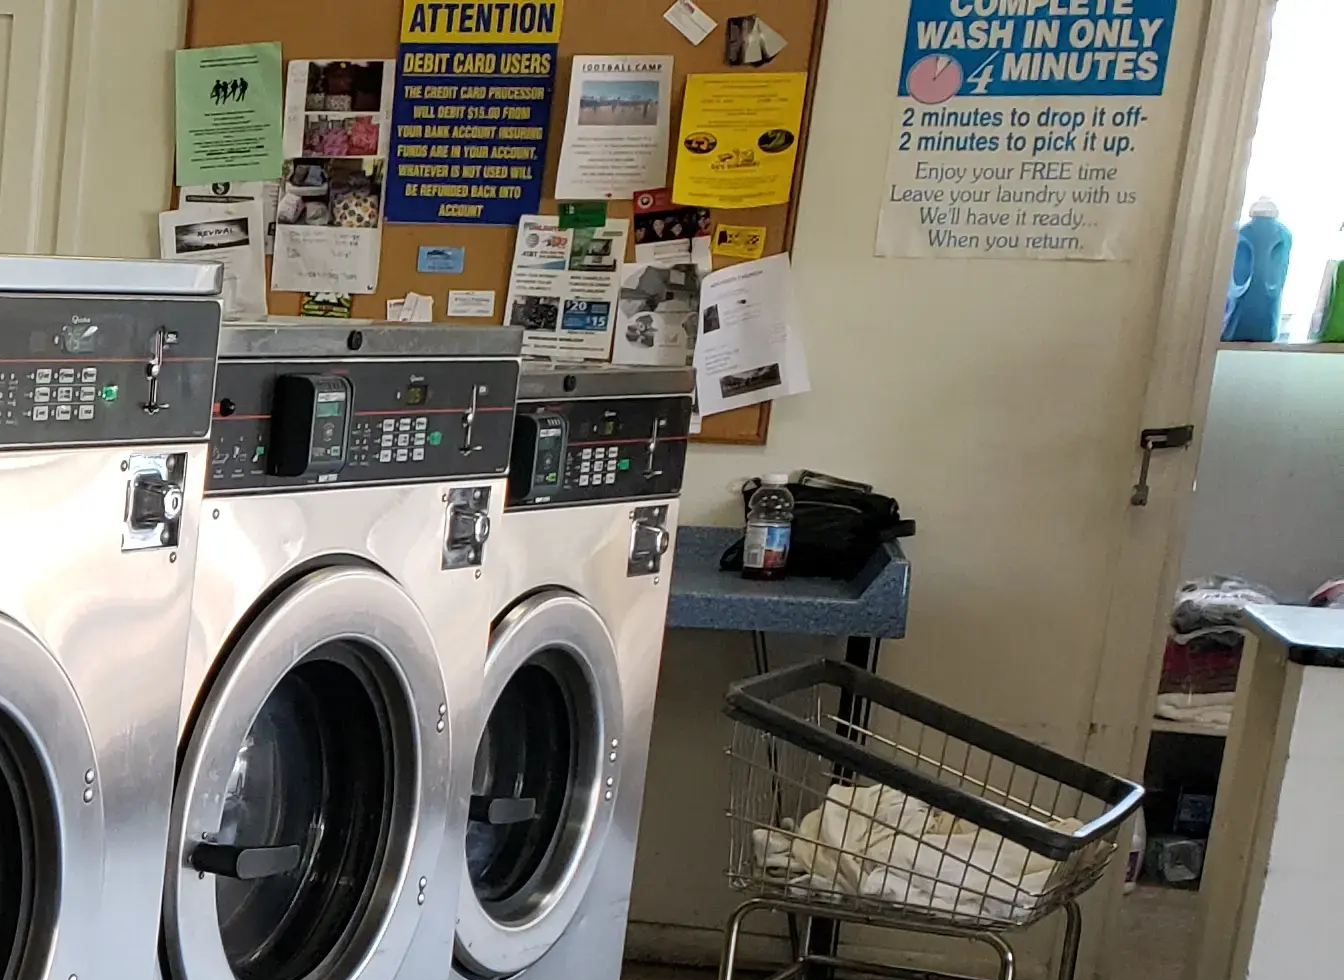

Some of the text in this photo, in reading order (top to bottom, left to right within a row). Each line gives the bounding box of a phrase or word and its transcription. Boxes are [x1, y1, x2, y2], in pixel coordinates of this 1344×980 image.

[409, 3, 556, 33] ATTENTION
[917, 18, 1164, 50] WASH IN ONLY
[403, 53, 552, 75] DEBIT CARD USERS
[582, 63, 663, 71] FOOTBALL CAMP
[966, 50, 1160, 94] 4 MINUTES
[404, 86, 545, 101] THE CREDIT CARD PROCESSOR
[414, 106, 531, 120] WILL DEBIT $15.00 FROM
[901, 106, 1149, 131] 2 minutes to drop it off-
[397, 125, 423, 138] YOUR
[424, 126, 450, 139] BANK
[452, 126, 497, 139] ACCOUNT
[397, 145, 428, 158] FUNDS
[429, 145, 450, 158] ARE
[451, 145, 462, 158] IN
[464, 145, 490, 159] YOUR
[898, 131, 1136, 157] 2 minutes to pick it up.
[398, 164, 533, 180] WHATEVER IS NOT USED WILL
[914, 161, 1118, 184] Enjoy your FREE time
[405, 184, 522, 199] BE REFUNDED BACK INTO
[890, 184, 1137, 206] Leave your laundry with us
[438, 204, 484, 218] ACCOUNT
[919, 206, 961, 226] We'll
[966, 207, 1010, 226] have
[1015, 207, 1028, 226] it
[197, 227, 234, 238] REVIVAL
[928, 229, 1085, 251] When you return.
